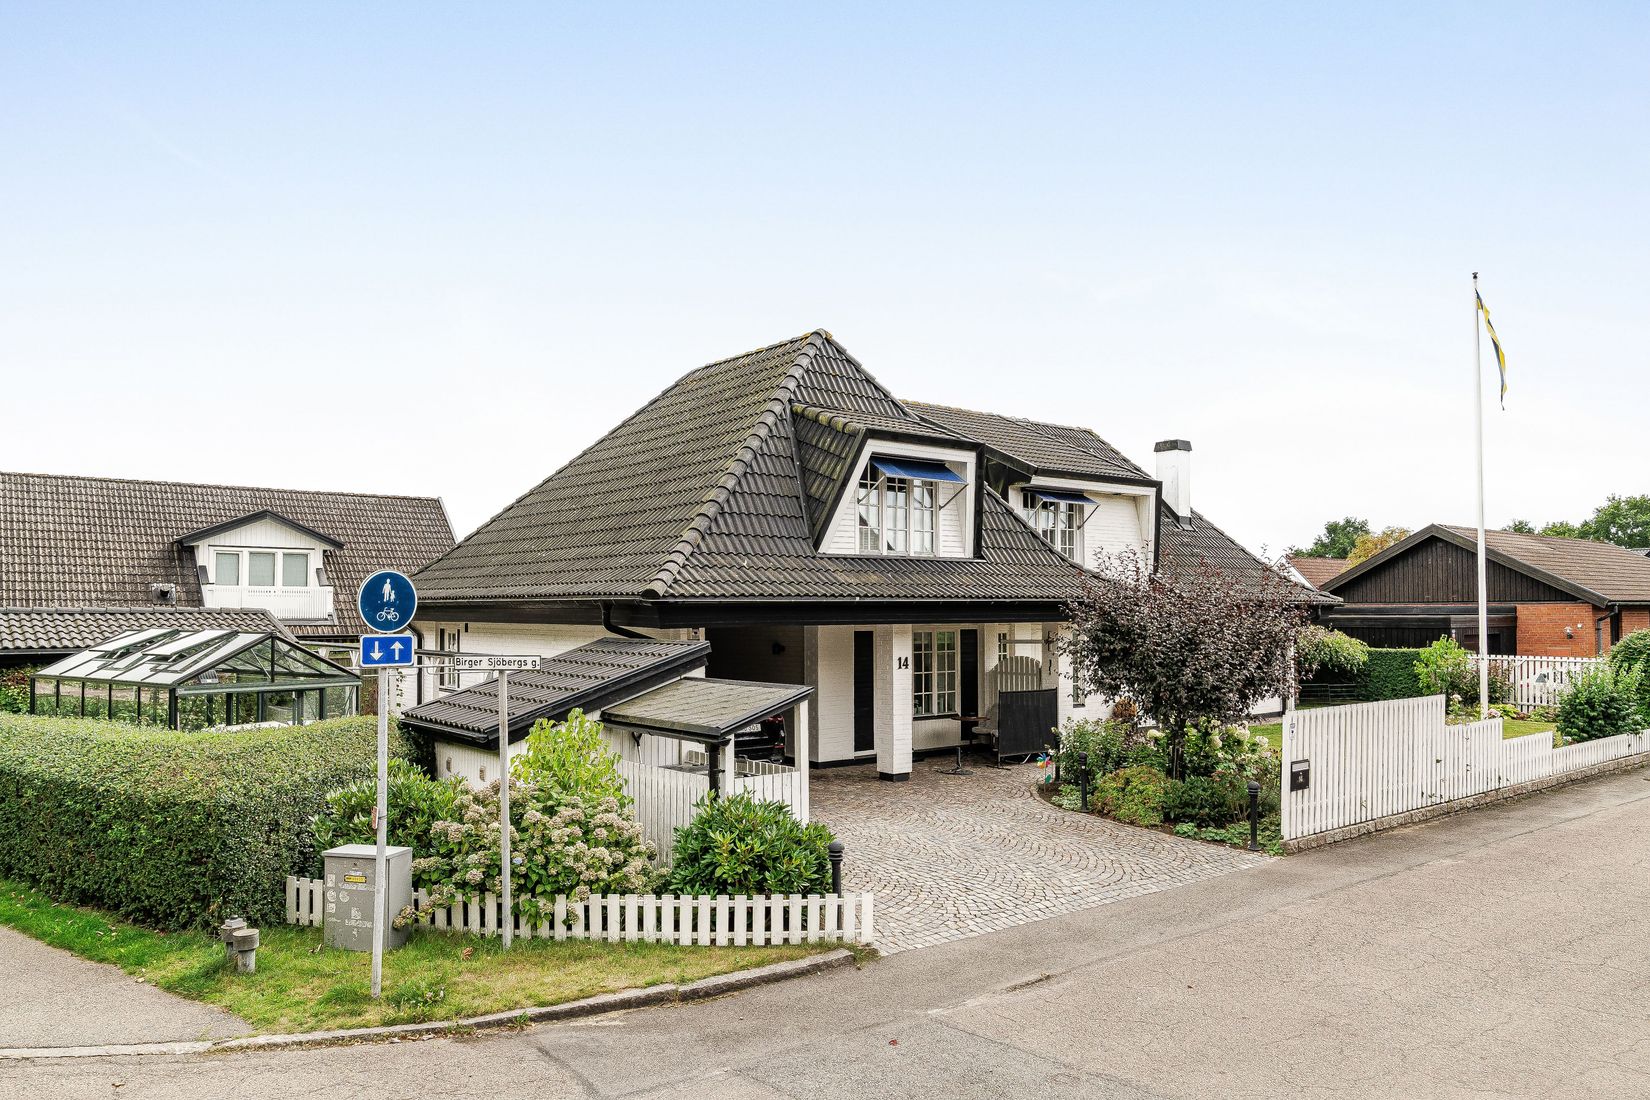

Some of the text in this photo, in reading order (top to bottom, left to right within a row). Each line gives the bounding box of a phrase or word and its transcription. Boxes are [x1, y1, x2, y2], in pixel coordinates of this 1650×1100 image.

[455, 657, 540, 669] Birger Sjöbergs g.
[897, 656, 910, 670] 14
